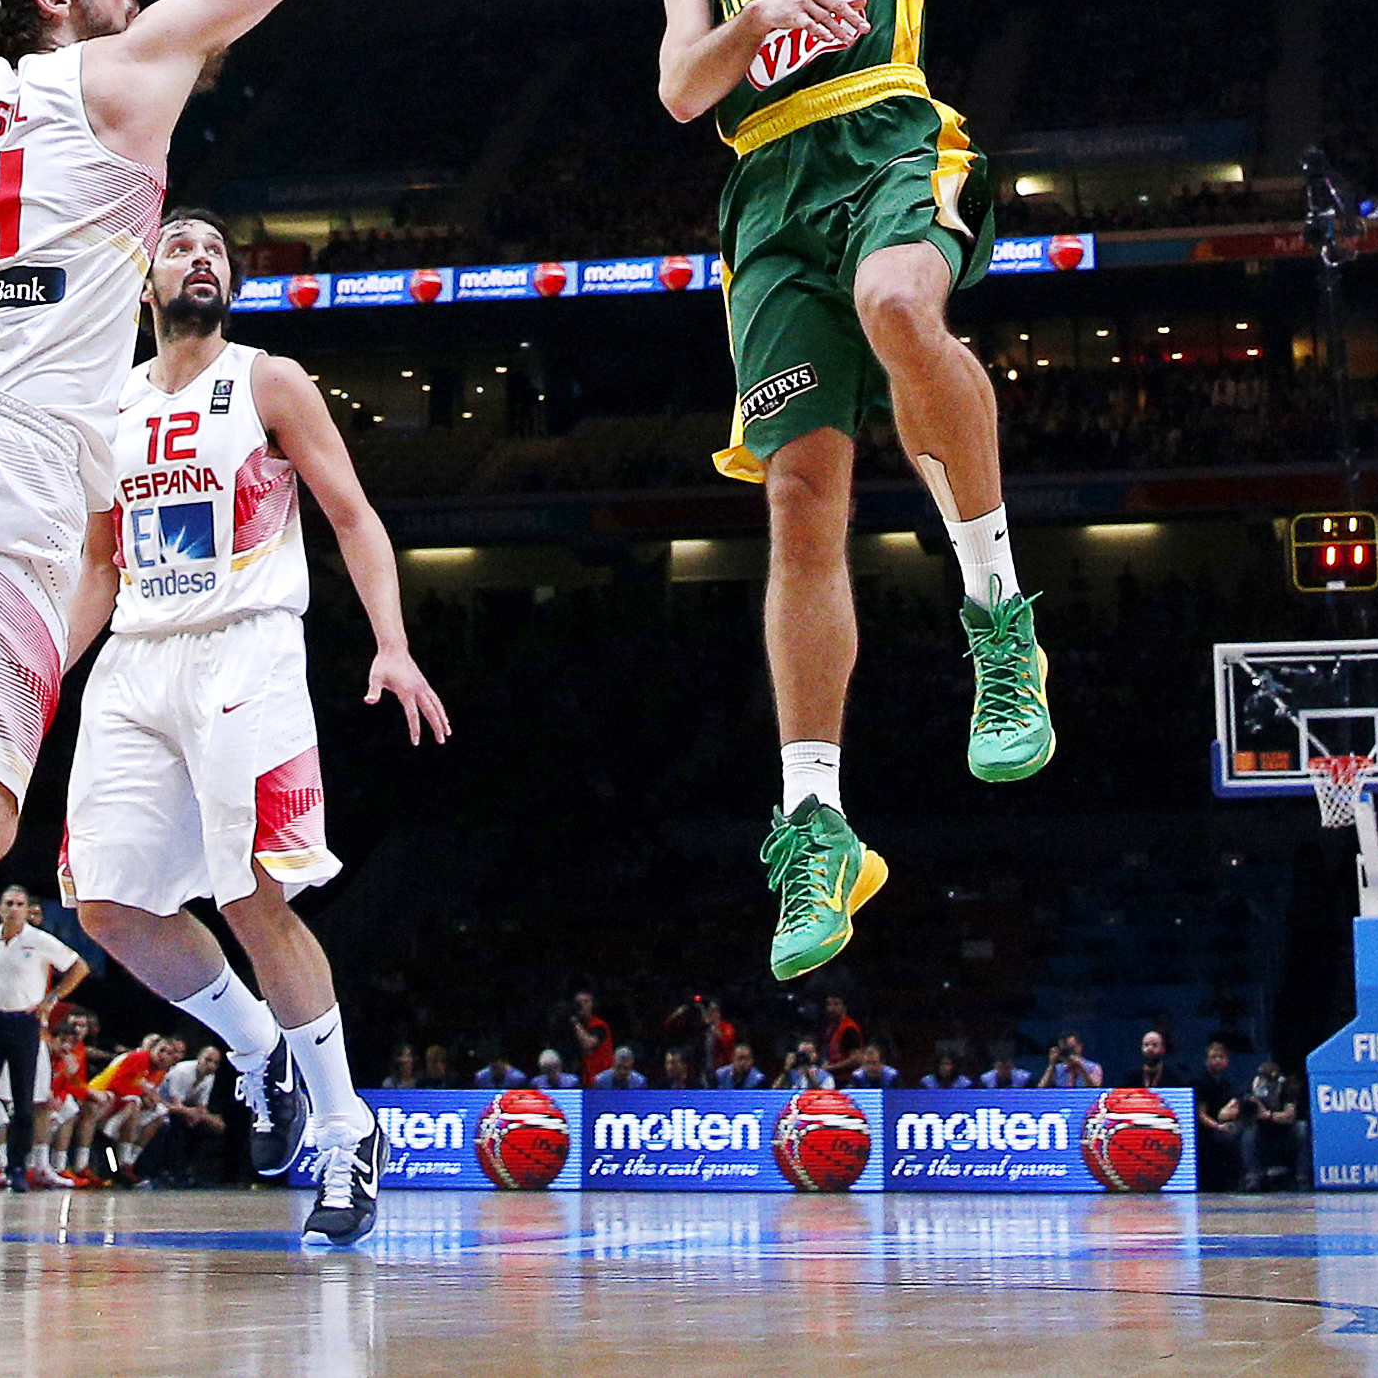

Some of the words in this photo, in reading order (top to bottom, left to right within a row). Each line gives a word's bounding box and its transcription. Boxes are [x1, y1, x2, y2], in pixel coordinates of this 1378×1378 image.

[336, 275, 404, 294] molten
[459, 269, 527, 288] molten
[584, 263, 654, 282] molten
[146, 411, 200, 464] 12
[121, 464, 223, 502] ESPAÑA
[141, 569, 216, 598] endesa
[594, 1109, 761, 1151] molten
[896, 1108, 1070, 1150] molten
[621, 1154, 657, 1176] the
[701, 1163, 760, 1181] game
[926, 1154, 962, 1177] the
[1009, 1162, 1069, 1181] game
[1319, 1163, 1362, 1184] LILLE
